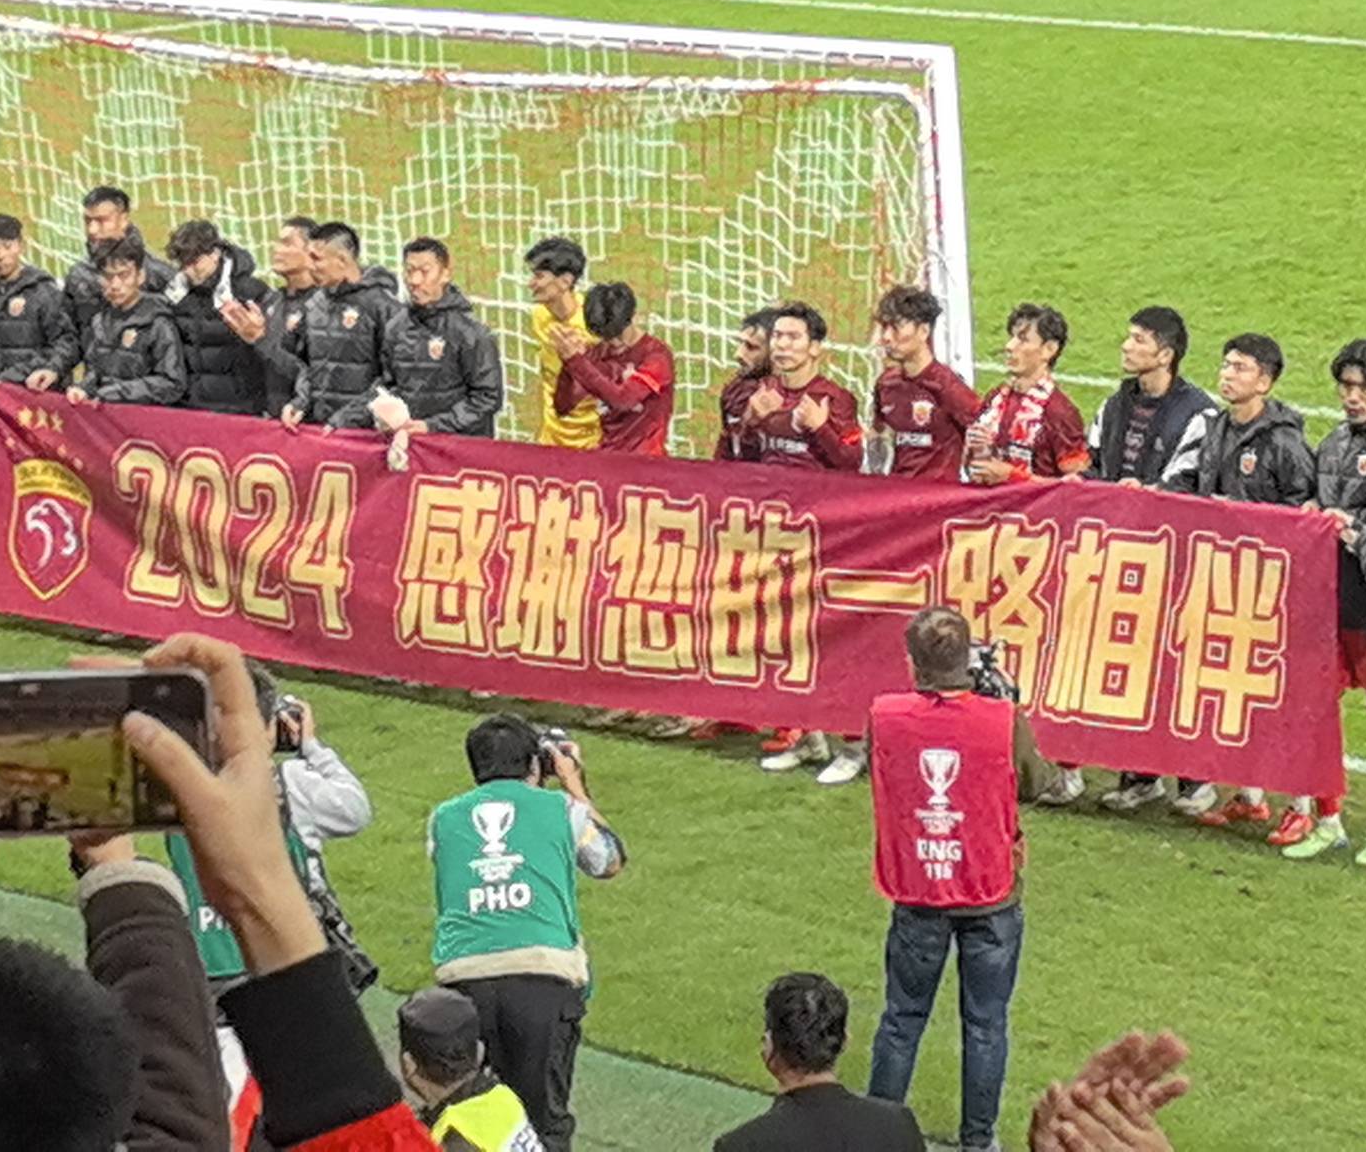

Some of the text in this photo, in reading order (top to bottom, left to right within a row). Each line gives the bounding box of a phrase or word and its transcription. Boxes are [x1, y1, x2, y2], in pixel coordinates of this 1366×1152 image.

[112, 439, 356, 638] 2024
[395, 469, 1290, 746] 感谢您的一路相伴
[468, 882, 532, 917] PHO
